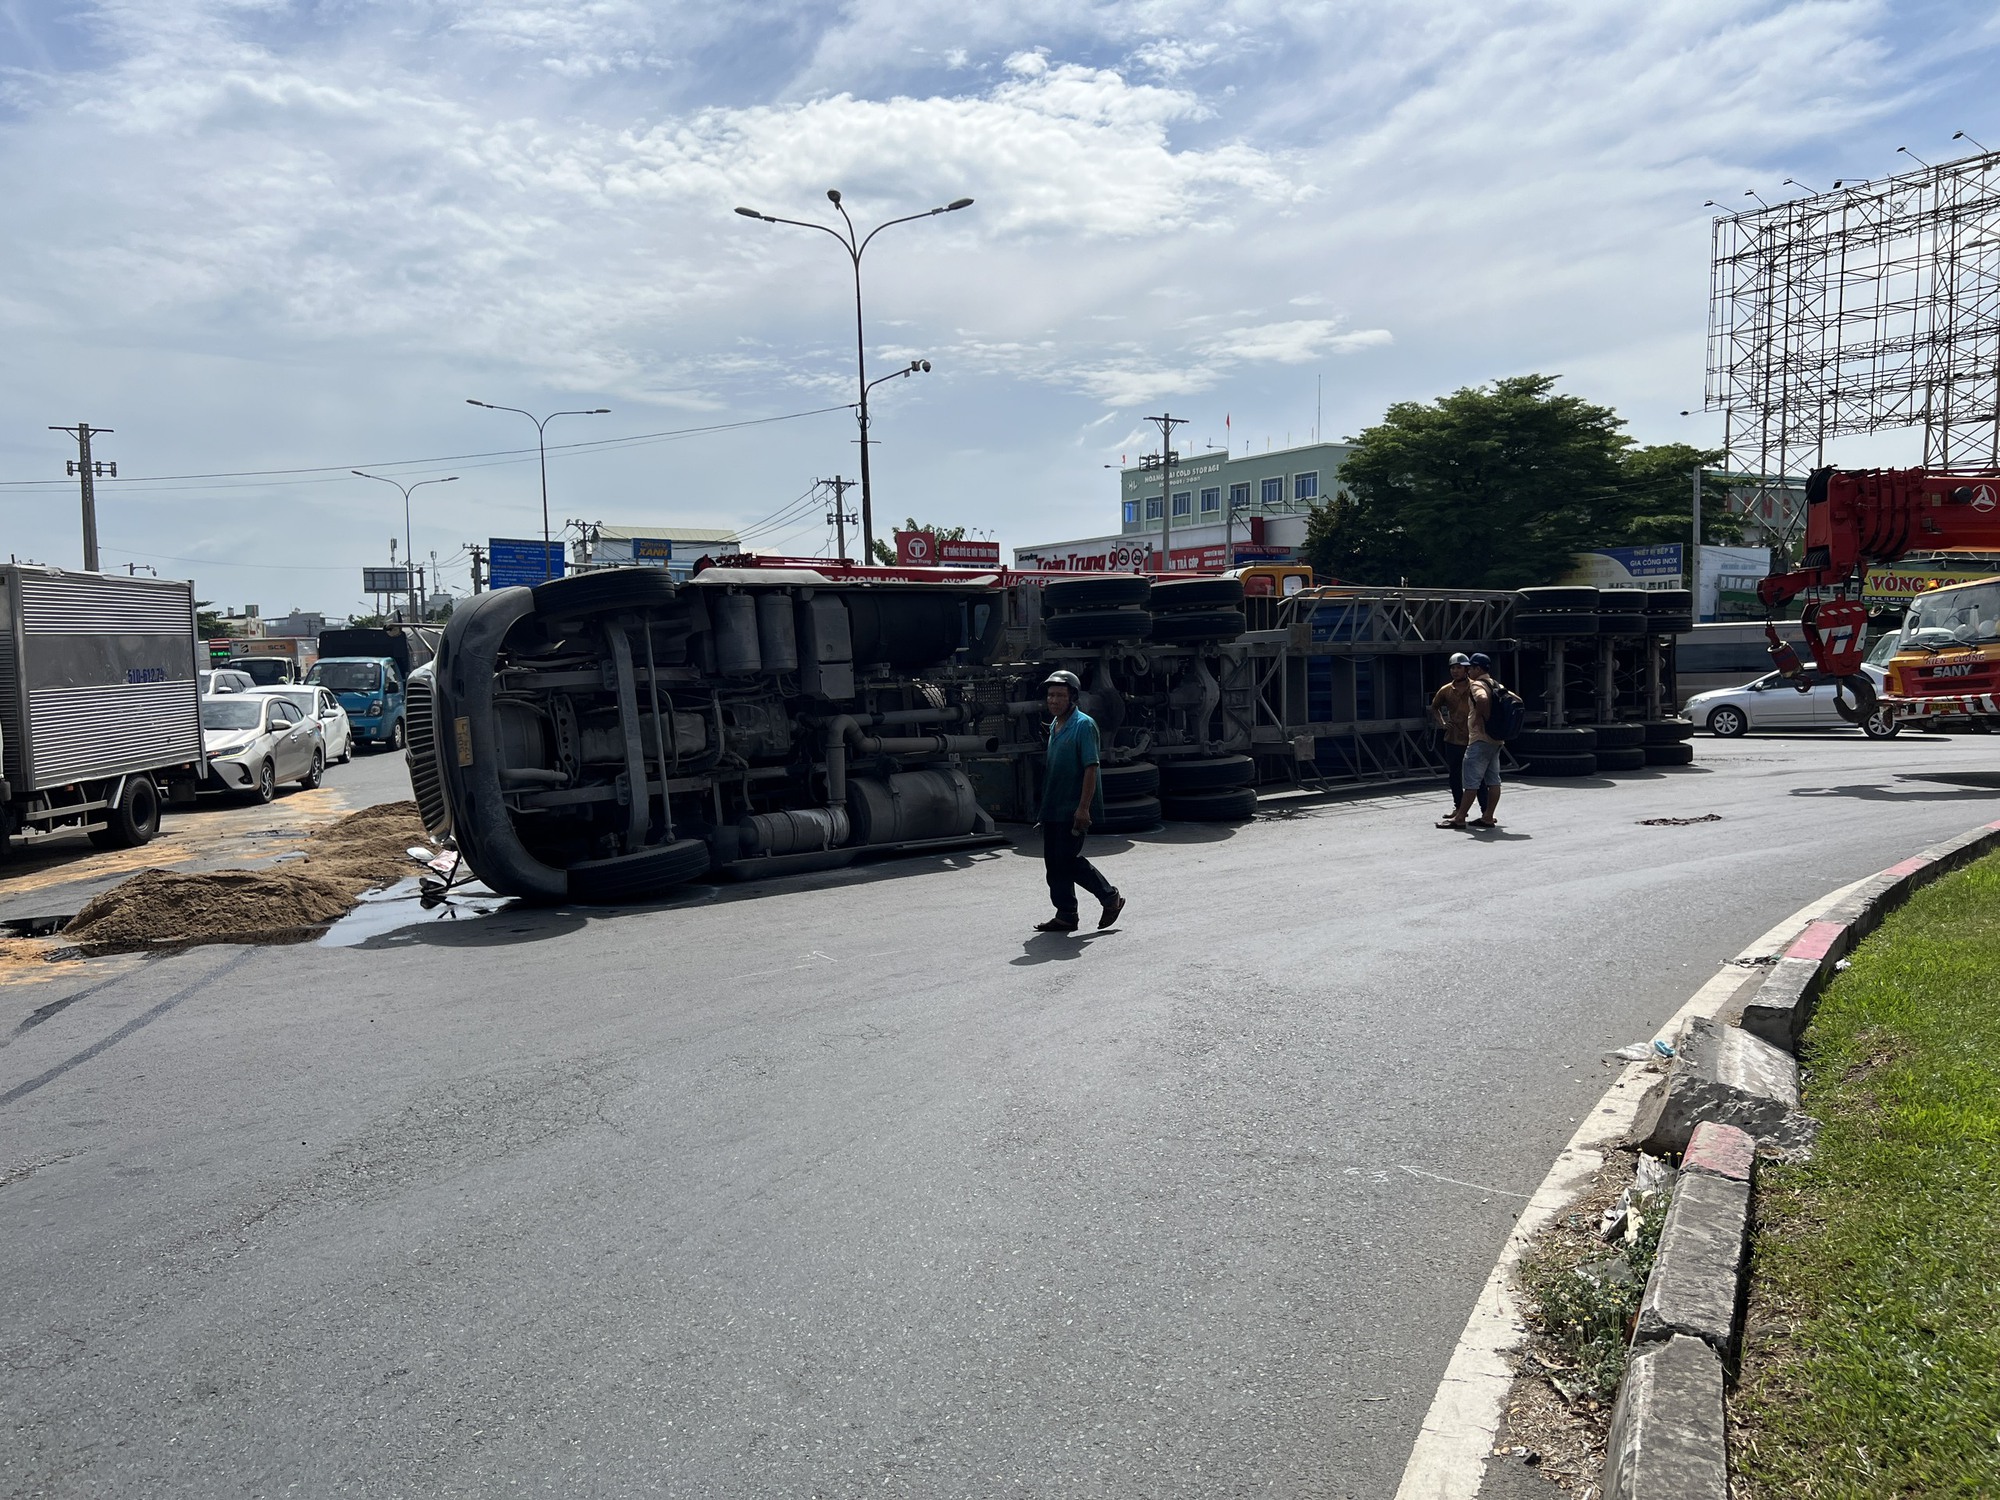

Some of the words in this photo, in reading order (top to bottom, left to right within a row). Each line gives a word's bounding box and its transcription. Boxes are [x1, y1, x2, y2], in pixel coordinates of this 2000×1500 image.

[1176, 469, 1191, 477] COLD
[1192, 464, 1220, 475] STORAGE
[1642, 557, 1661, 566] CÔNG
[1662, 557, 1678, 565] INOX
[1869, 571, 1925, 592] VÒNG
[1933, 664, 1973, 678] SANY
